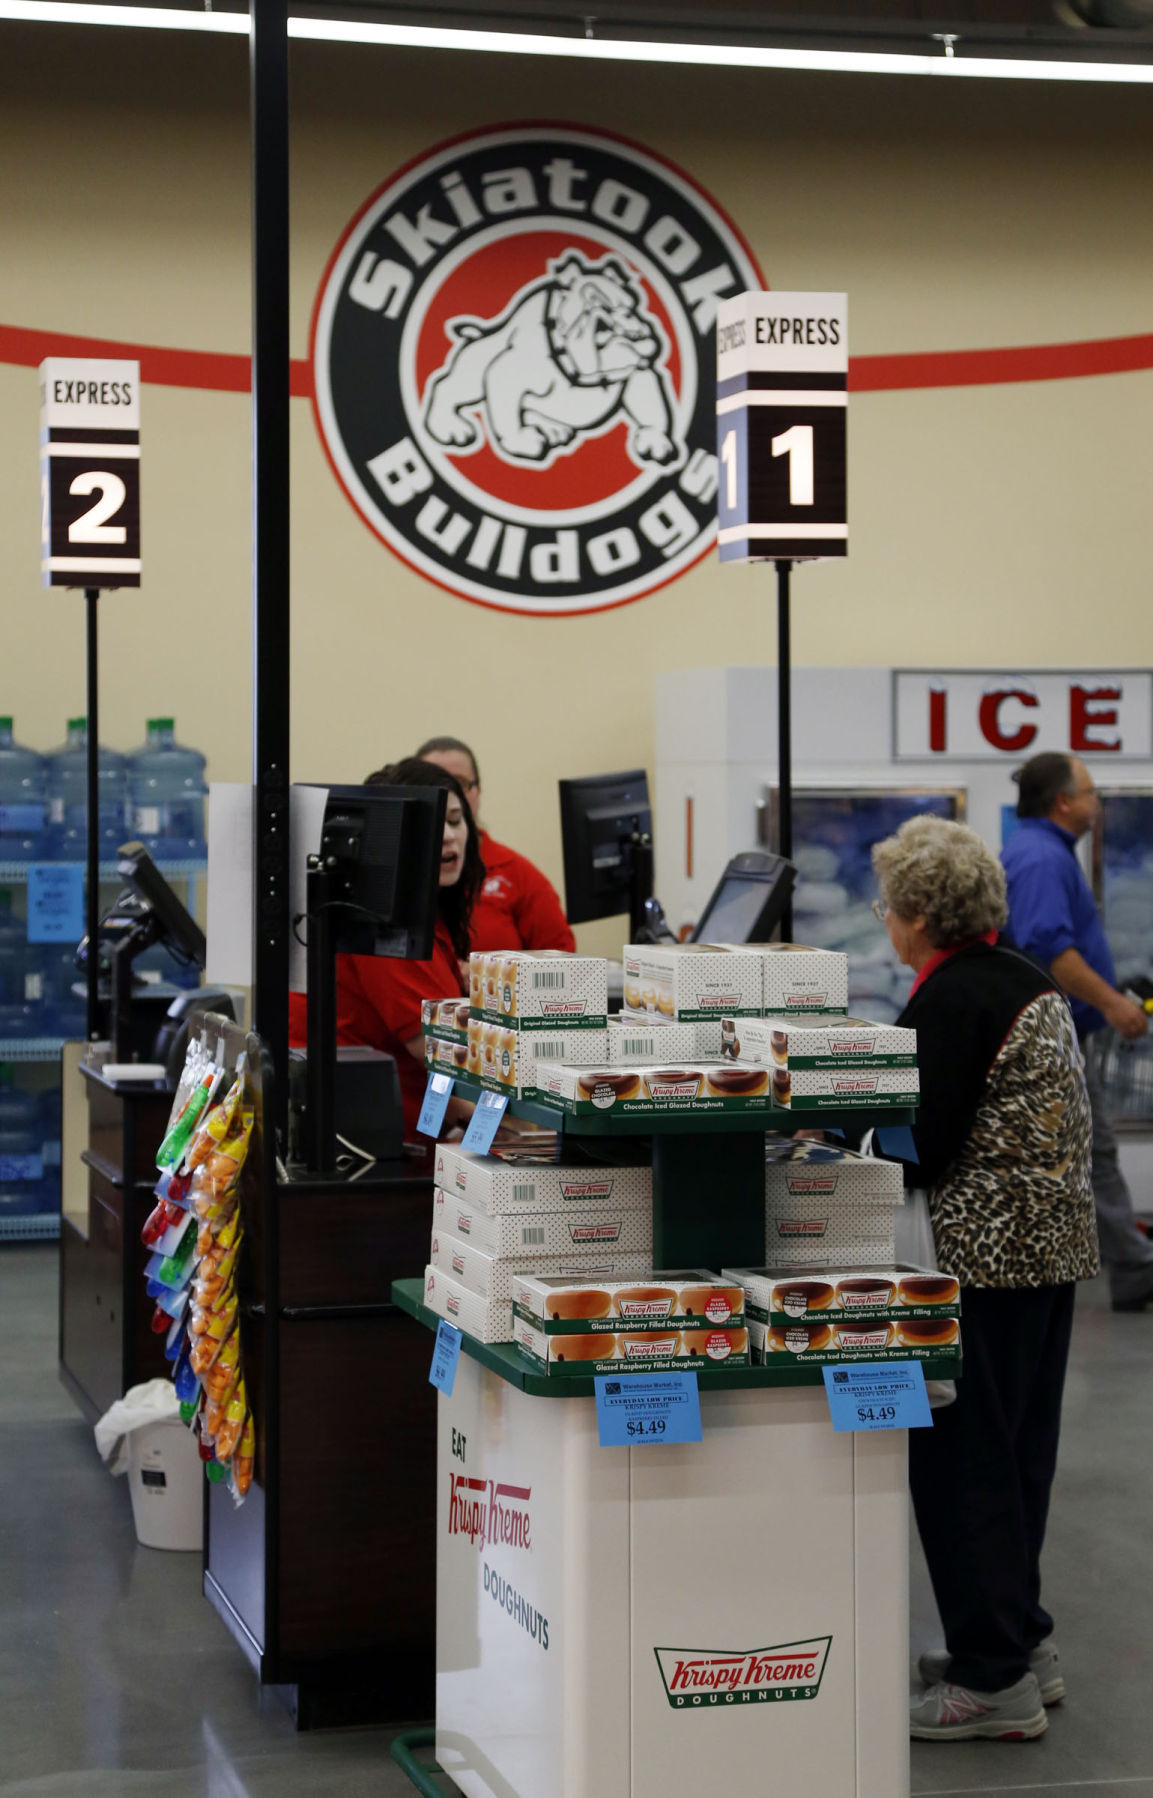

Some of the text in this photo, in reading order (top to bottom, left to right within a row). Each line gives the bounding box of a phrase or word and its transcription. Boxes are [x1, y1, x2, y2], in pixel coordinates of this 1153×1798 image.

[349, 158, 745, 335] Skiatook
[755, 317, 840, 345] EXPRESS
[53, 379, 132, 406] EXPRESS
[719, 430, 737, 509] 1
[772, 425, 815, 506] 1
[68, 470, 127, 545] 2
[366, 435, 718, 584] Bulldogs
[928, 675, 1122, 753] ICE
[692, 1101, 724, 1109] Doughnuts
[591, 1322, 614, 1330] Glazed
[615, 1321, 648, 1331] Raspberry
[648, 1320, 666, 1328] Filled
[667, 1320, 700, 1328] Doughnuts
[800, 1313, 829, 1321] Chocolate
[830, 1312, 843, 1320] Iced
[844, 1311, 875, 1320] Doughnuts
[876, 1310, 890, 1318] with
[913, 1308, 932, 1317] Filling
[596, 1364, 618, 1372] Glazed
[620, 1362, 652, 1372] Raspberry
[653, 1361, 671, 1369] Filled
[671, 1360, 705, 1370] Doughnuts
[796, 1348, 930, 1362] Chocolate Iced Doughnuts with Kreme Filling
[626, 1420, 666, 1436] $4.49
[857, 1406, 896, 1423] $4.49
[451, 1426, 467, 1464] EAT
[448, 1472, 532, 1552] Krispy Kreme
[483, 1561, 549, 1651] DOUGHNUTS
[669, 1651, 819, 1691] Krispy Kreme
[676, 1688, 811, 1706] DOUGHNUTS
